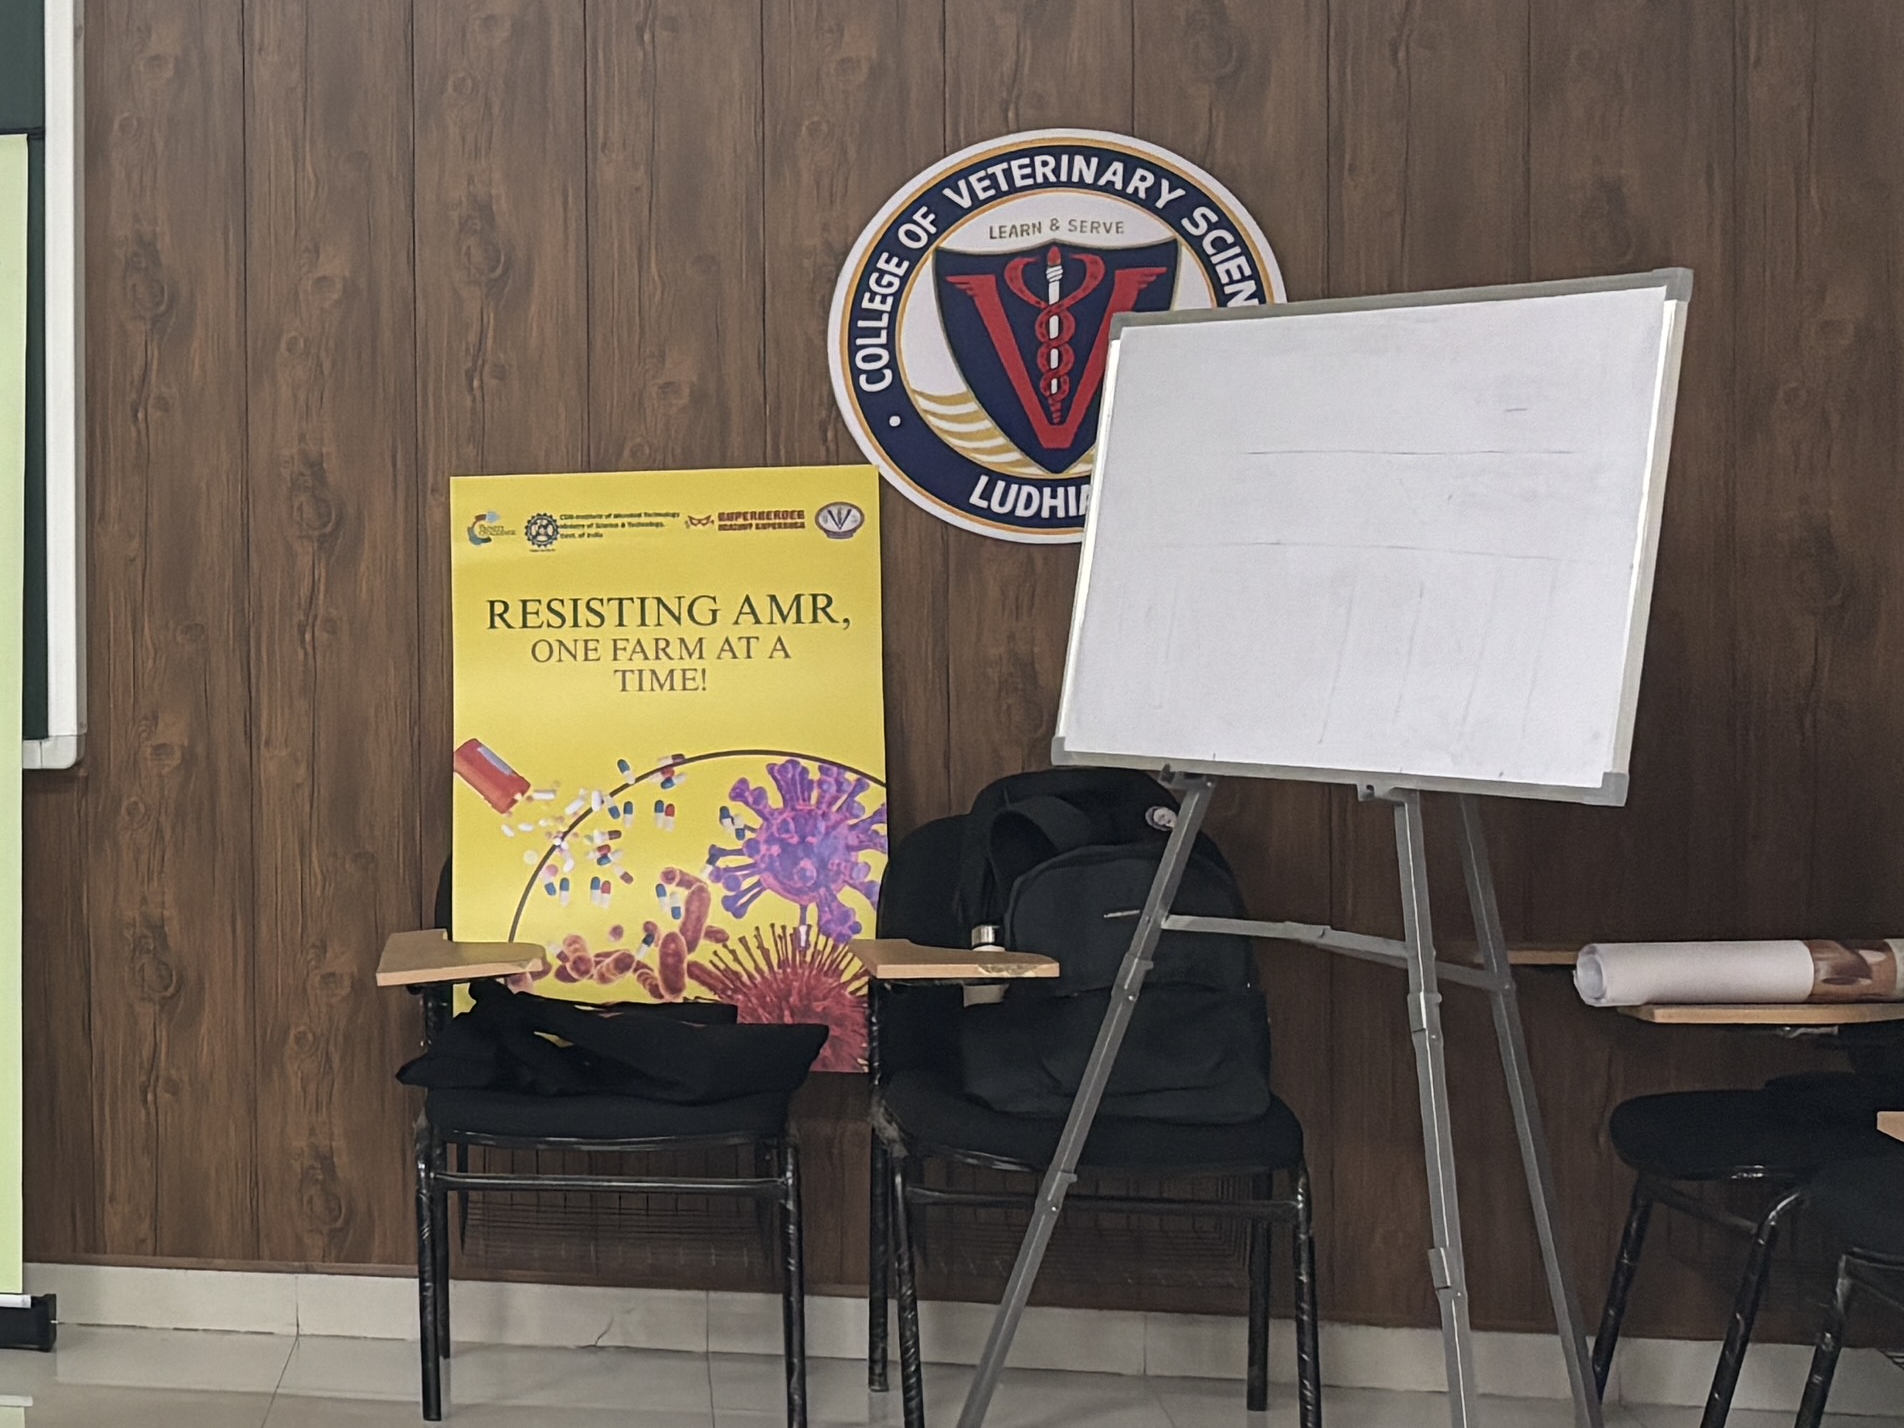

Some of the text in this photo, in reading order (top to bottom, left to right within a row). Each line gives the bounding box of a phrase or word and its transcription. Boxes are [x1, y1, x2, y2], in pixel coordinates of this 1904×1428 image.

[989, 218, 1125, 239] LEARN & SERVE
[855, 252, 909, 393] COLLEGE
[897, 206, 938, 250] OF
[942, 154, 1187, 211] VETERINARY
[487, 594, 850, 630] RESISTING AMR,
[532, 636, 791, 662] ONE FARM AT A
[614, 668, 706, 692] TIME!
